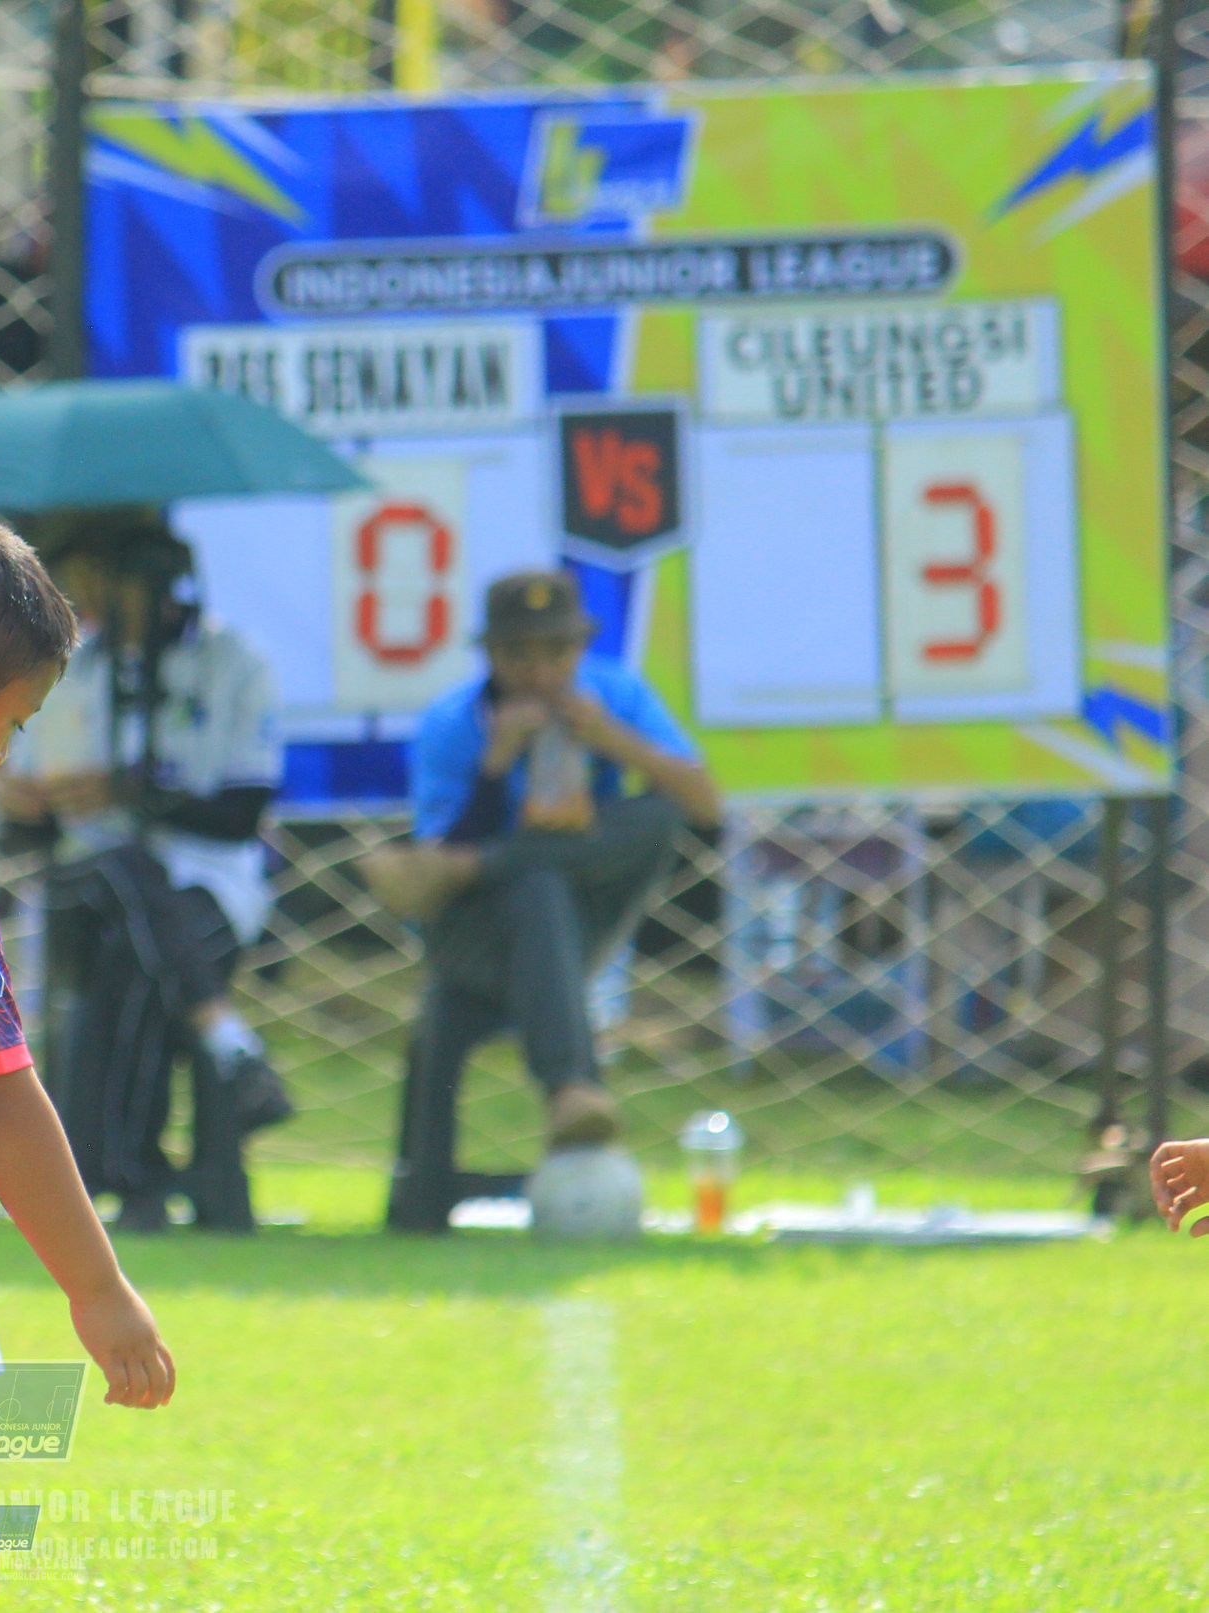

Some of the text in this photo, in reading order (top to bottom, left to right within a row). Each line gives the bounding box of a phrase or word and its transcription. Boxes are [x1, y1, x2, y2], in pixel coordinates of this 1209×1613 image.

[751, 242, 939, 286] LEAGUE
[726, 311, 1028, 368] CILEUNGSI
[772, 361, 984, 417] UNITED
[572, 431, 664, 534] VS
[354, 504, 452, 663] 0
[921, 481, 999, 661] 3
